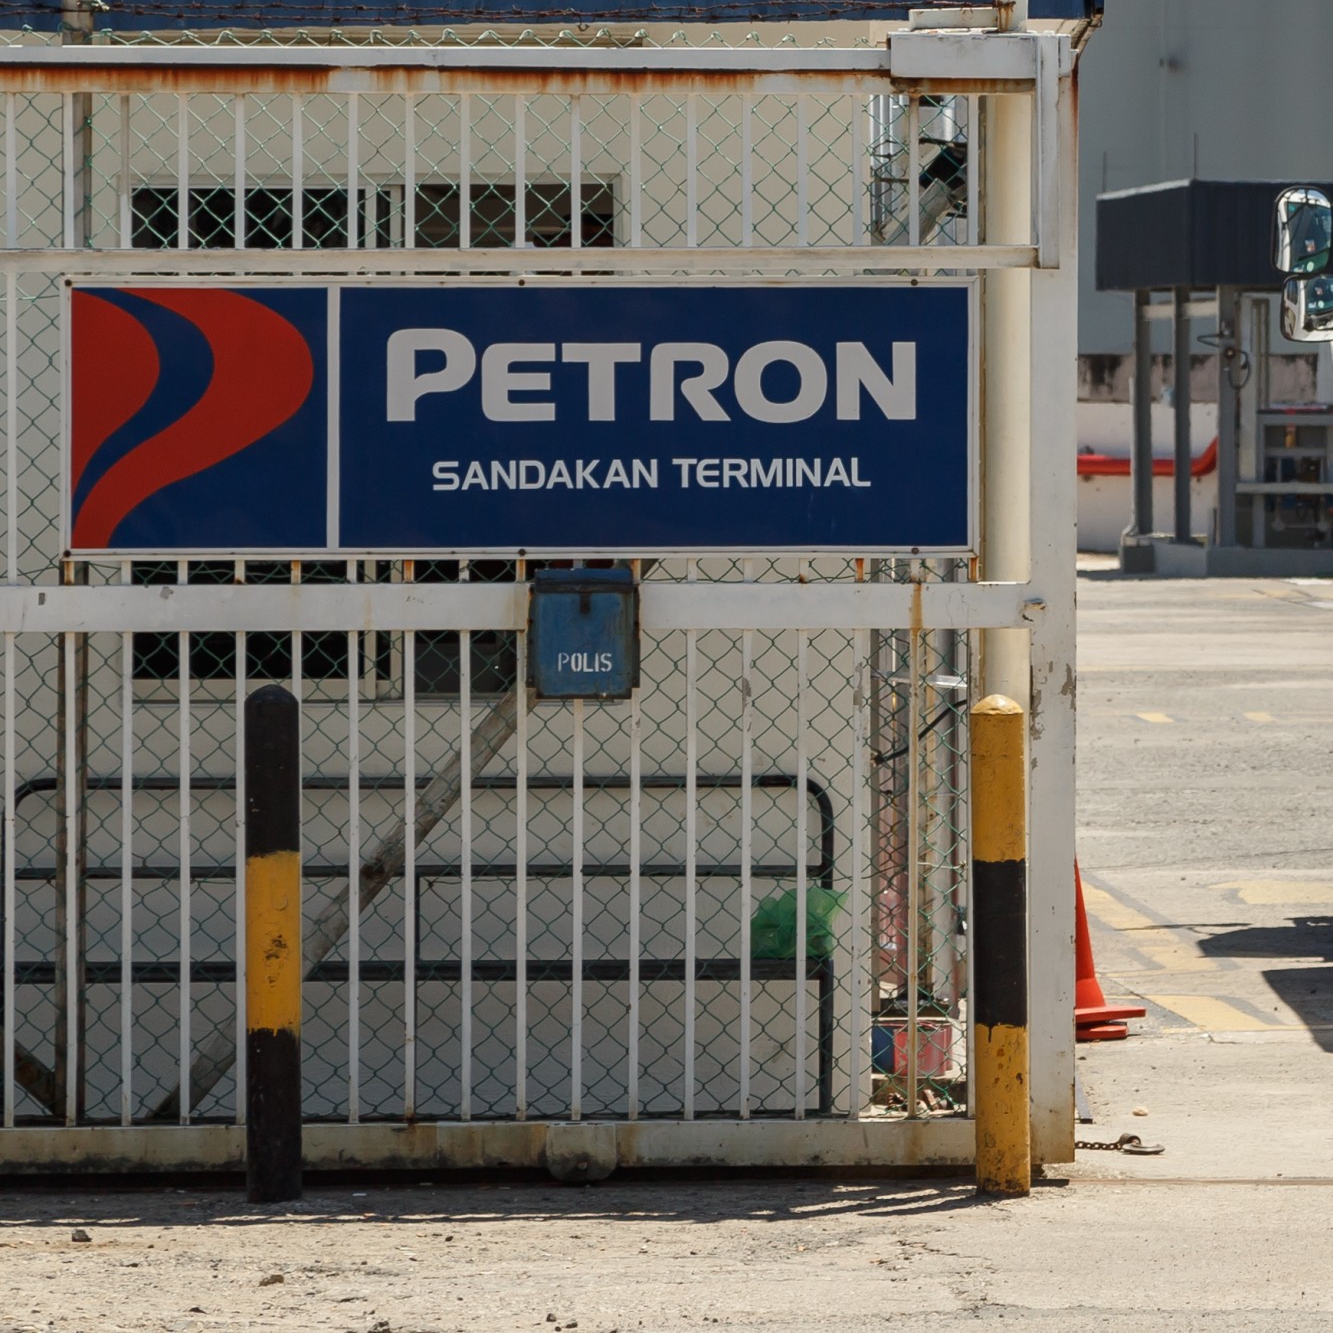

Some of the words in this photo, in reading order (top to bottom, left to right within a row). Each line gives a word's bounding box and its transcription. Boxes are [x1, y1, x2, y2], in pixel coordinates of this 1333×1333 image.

[386, 327, 918, 424] PETRON
[430, 458, 659, 493] SANDAKAN
[671, 456, 872, 489] TERMINAL
[557, 652, 613, 673] POLIS
